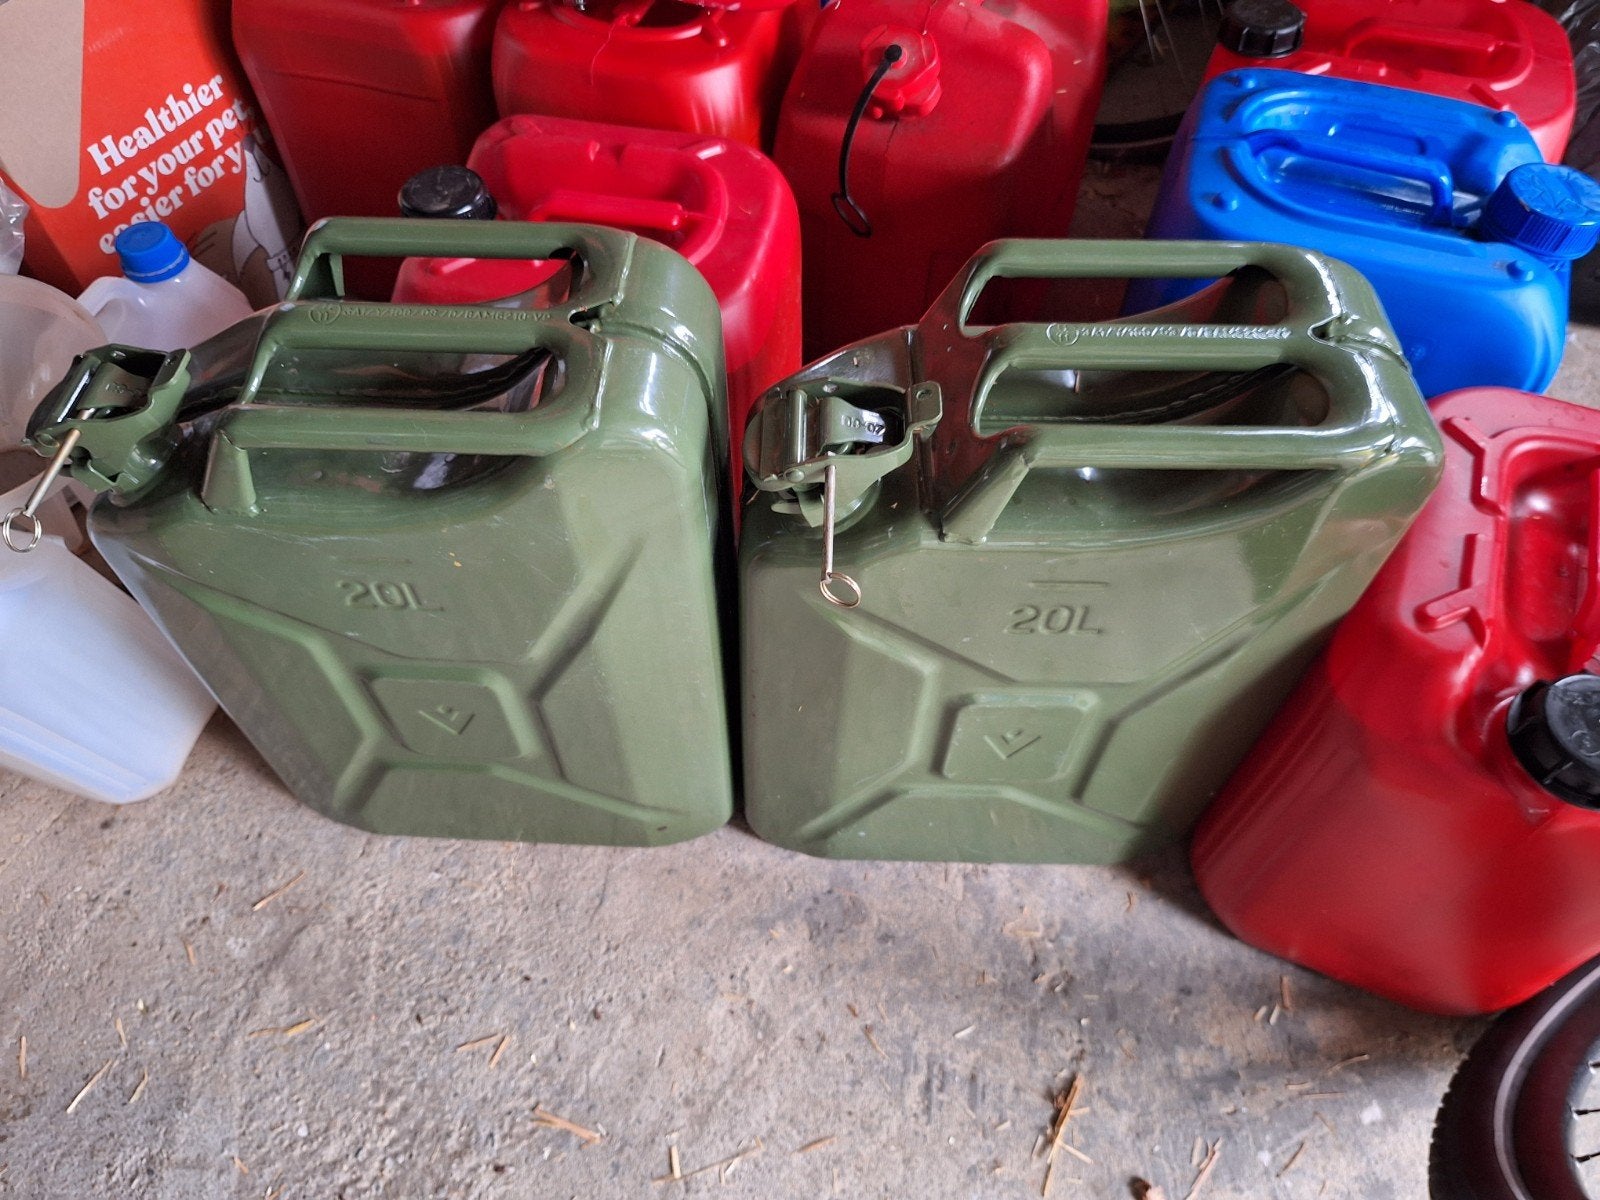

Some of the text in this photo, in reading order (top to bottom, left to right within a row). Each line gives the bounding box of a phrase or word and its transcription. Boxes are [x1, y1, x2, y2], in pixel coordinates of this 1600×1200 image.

[87, 74, 223, 175] Healthier
[88, 175, 138, 220] for
[137, 130, 205, 195] your
[184, 154, 226, 197] for
[335, 579, 445, 611] 20L
[1003, 604, 1104, 635] 20L
